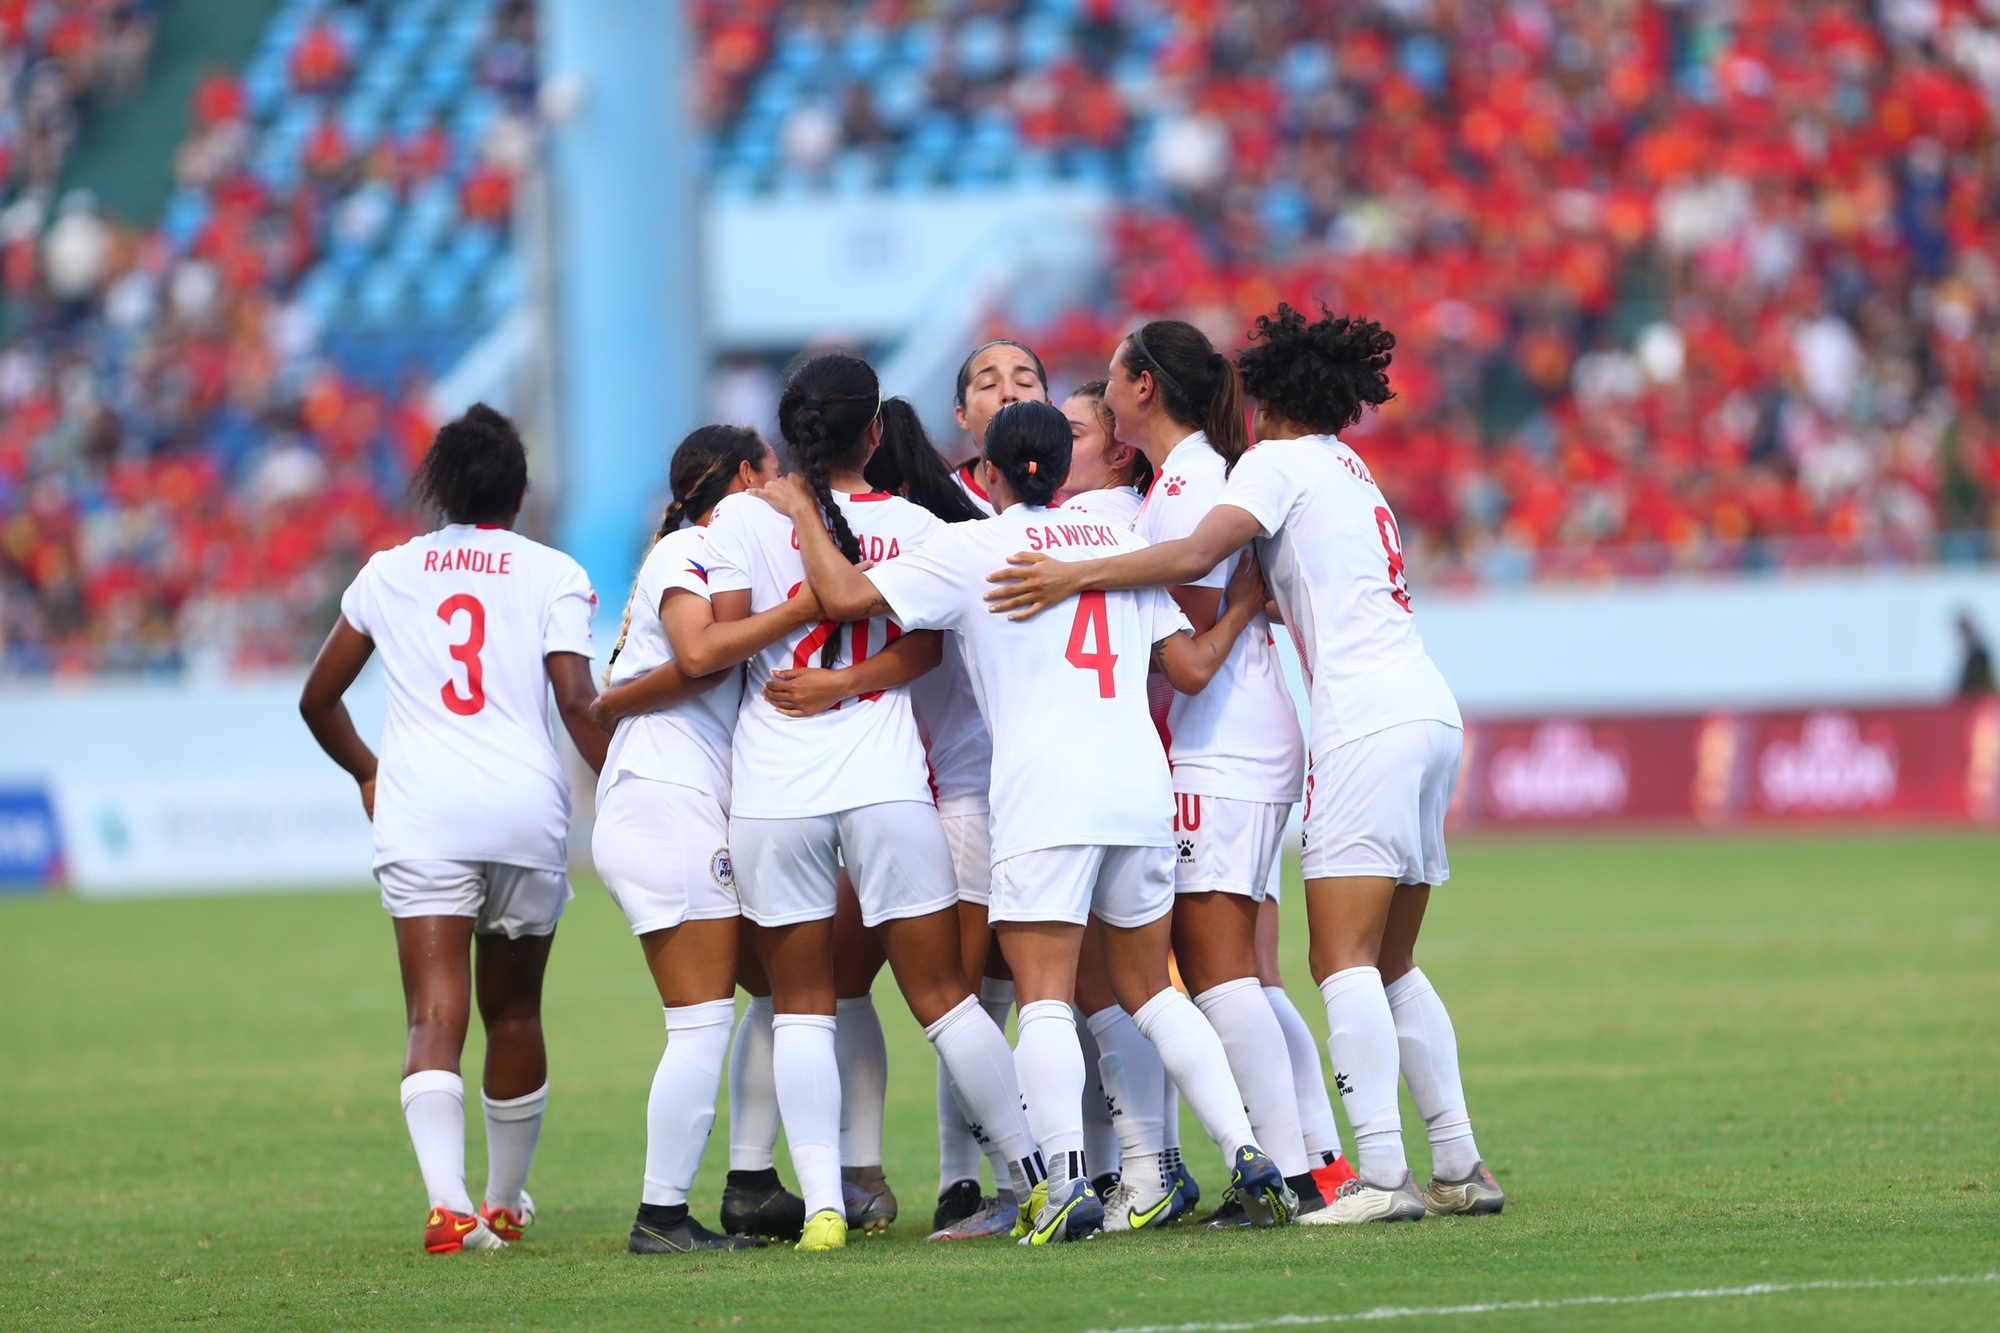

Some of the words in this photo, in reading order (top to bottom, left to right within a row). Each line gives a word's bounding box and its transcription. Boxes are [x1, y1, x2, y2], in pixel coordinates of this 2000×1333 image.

[424, 549, 512, 575] RANDLE
[1026, 525, 1119, 550] SAWICKI
[437, 593, 486, 716] 3
[1064, 590, 1119, 698] 4
